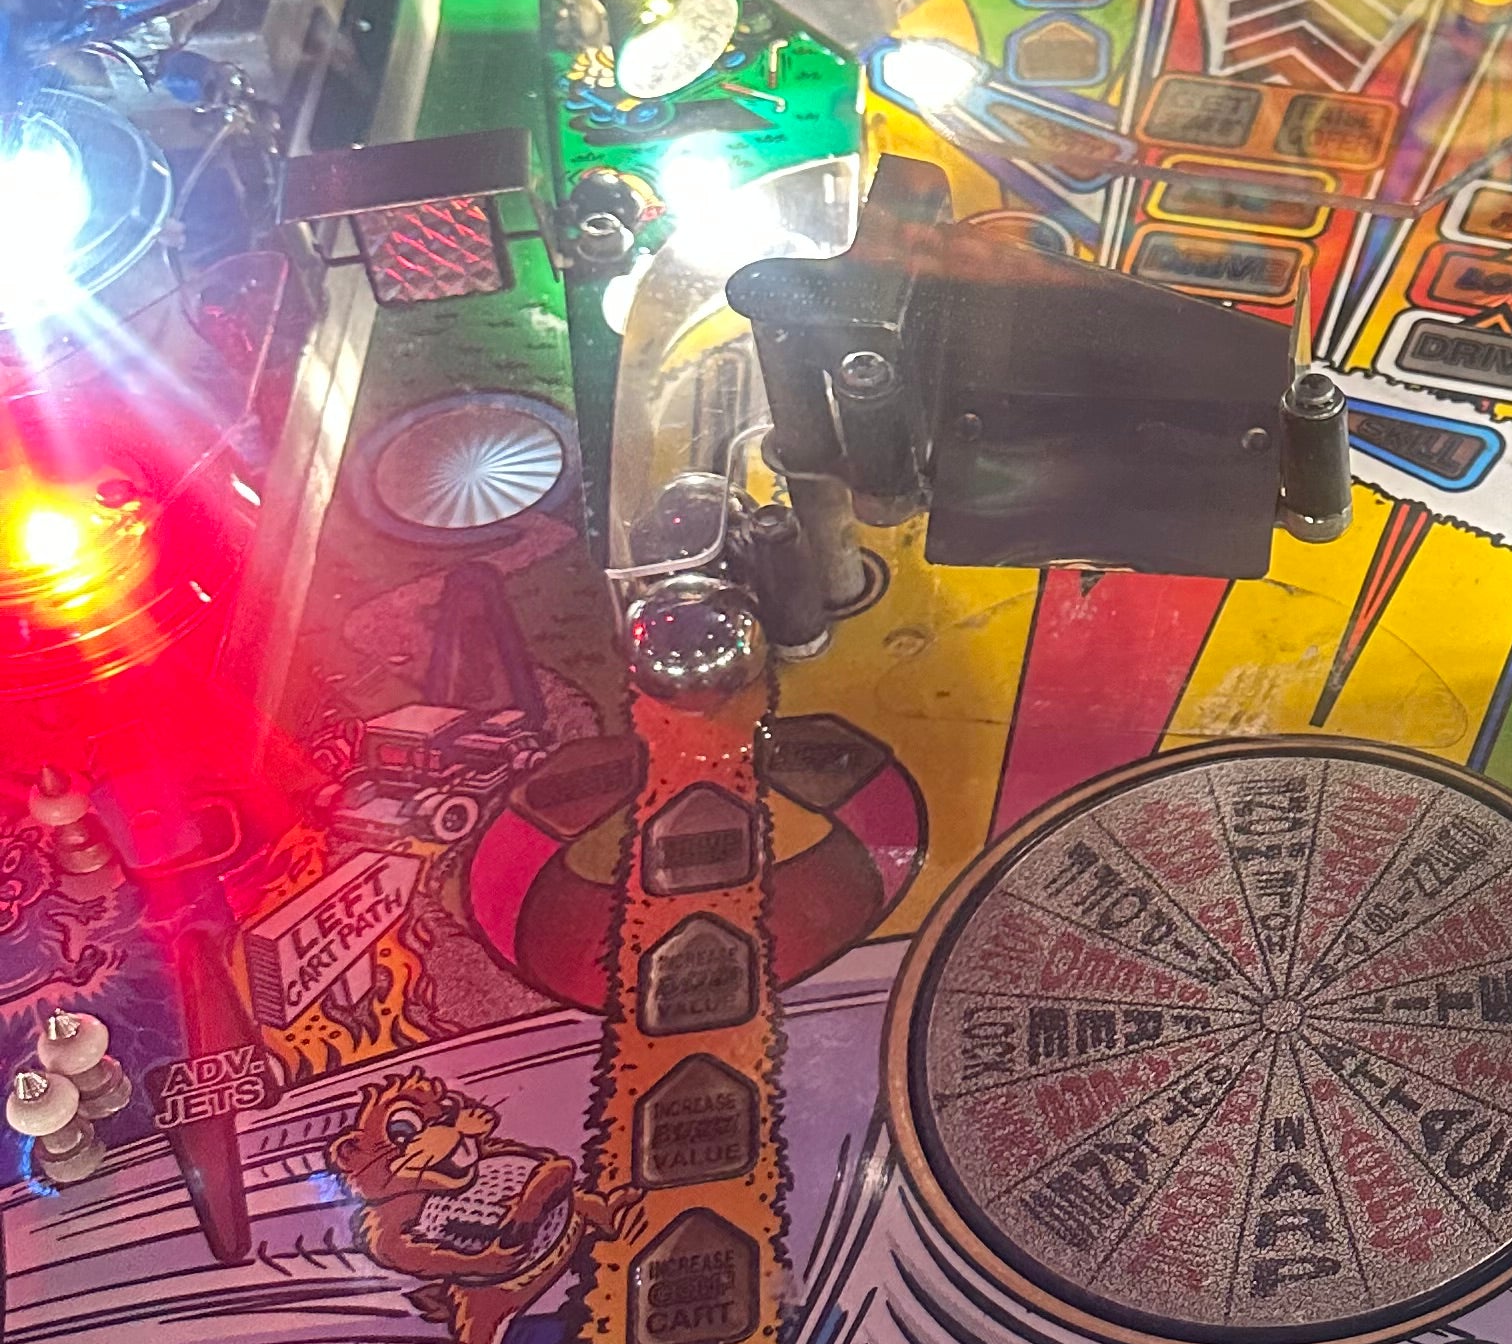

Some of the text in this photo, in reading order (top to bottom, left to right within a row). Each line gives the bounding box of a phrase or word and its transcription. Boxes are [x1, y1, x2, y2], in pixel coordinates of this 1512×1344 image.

[293, 862, 389, 955] LEFT
[287, 894, 403, 1006] CART PATH
[163, 1044, 266, 1097] ADV.
[958, 1003, 1209, 1084] FREE LOCK
[154, 1075, 266, 1130] JETS
[653, 1096, 738, 1123] INCREASE
[652, 1150, 741, 1181] VALUE
[1245, 1111, 1344, 1297] WARP
[647, 1251, 736, 1286] INCREASE
[645, 1306, 736, 1344] CART
